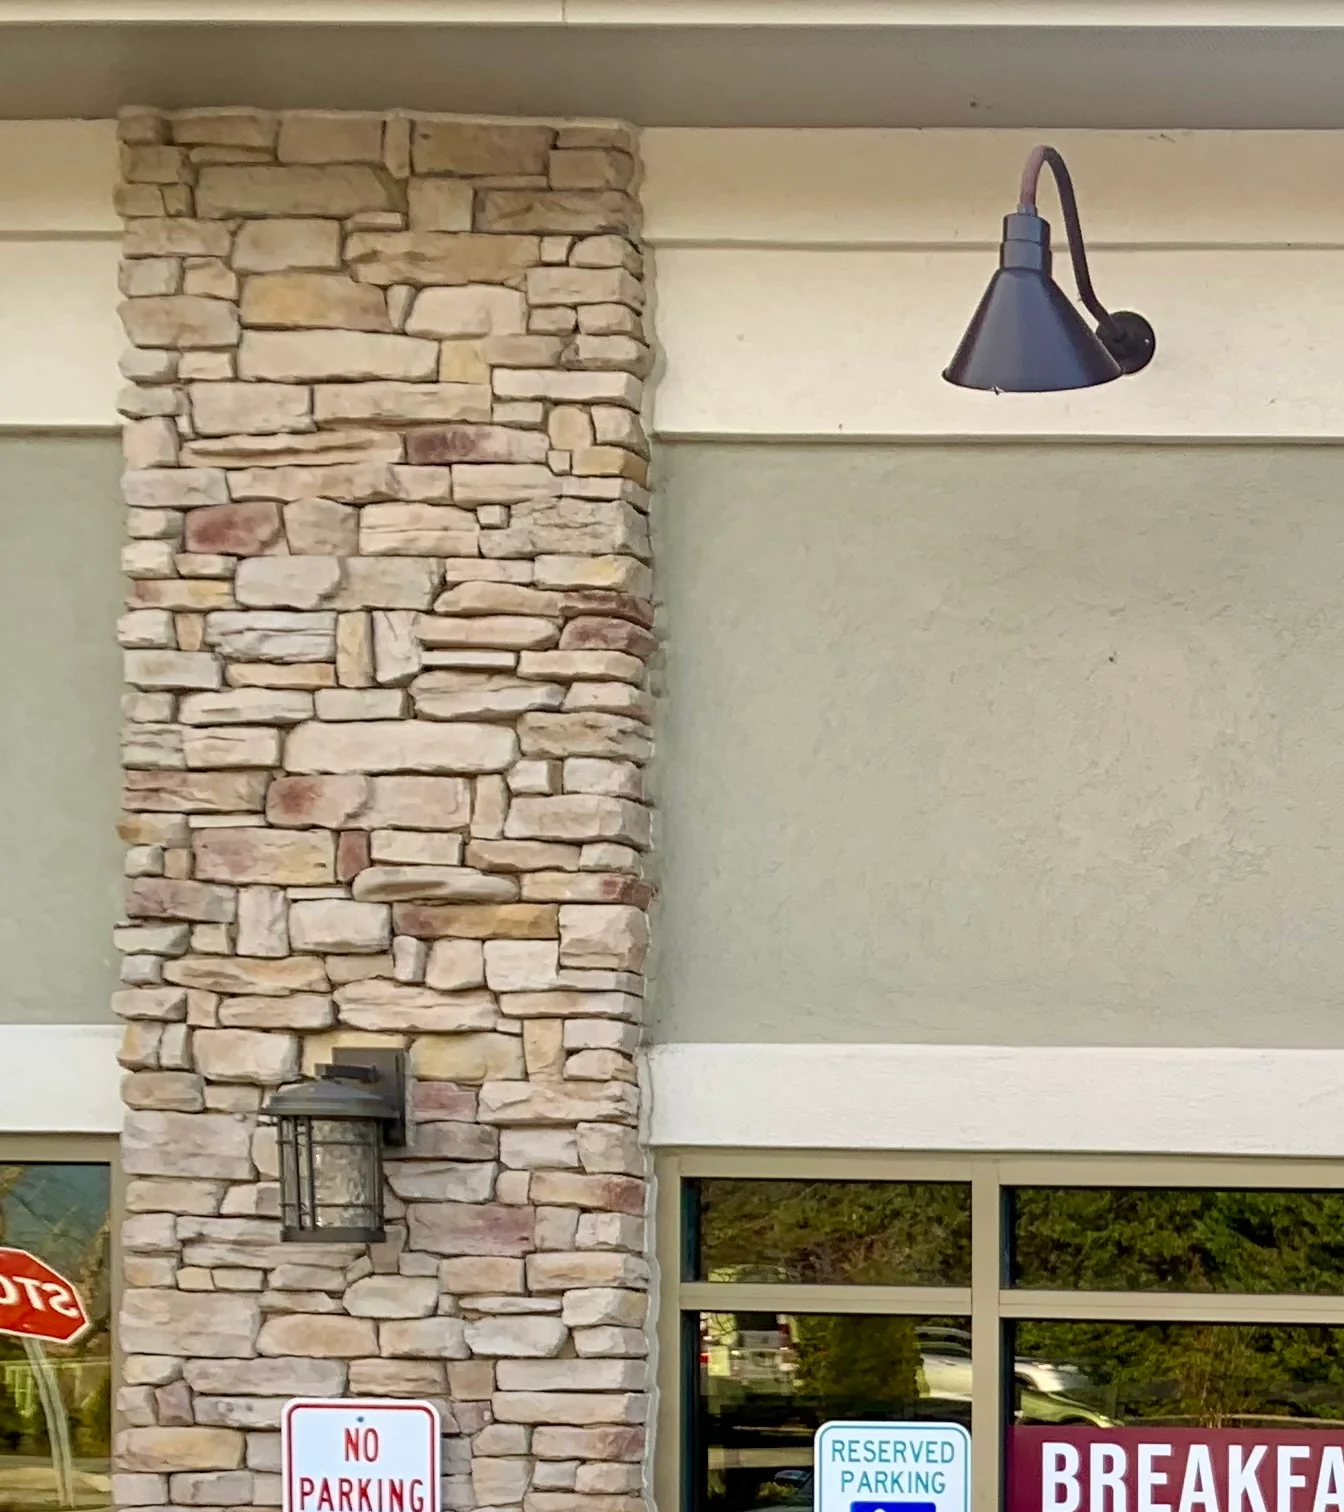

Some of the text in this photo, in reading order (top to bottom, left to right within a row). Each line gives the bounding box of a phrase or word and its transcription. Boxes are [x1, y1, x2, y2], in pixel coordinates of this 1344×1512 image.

[344, 1427, 379, 1462] NO
[831, 1439, 955, 1464] RESERVED
[299, 1477, 424, 1512] PARKING
[840, 1471, 946, 1494] PARKING
